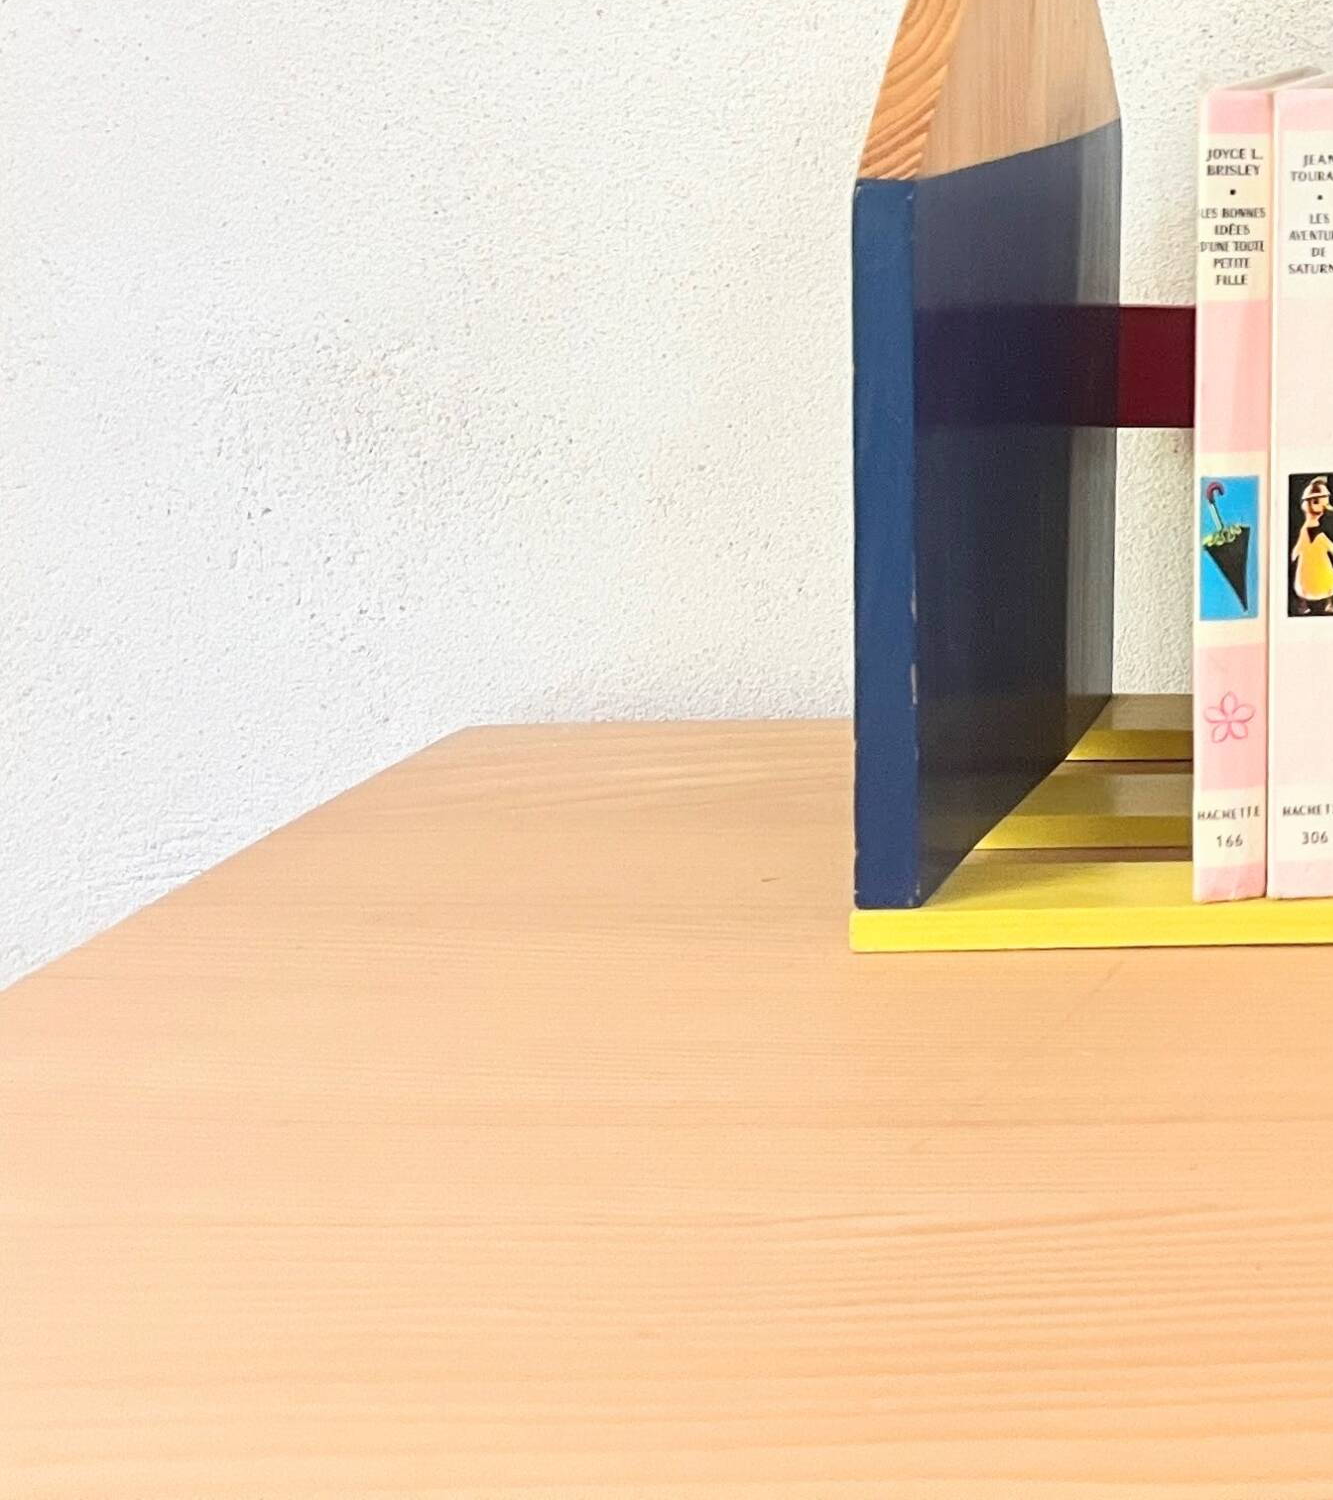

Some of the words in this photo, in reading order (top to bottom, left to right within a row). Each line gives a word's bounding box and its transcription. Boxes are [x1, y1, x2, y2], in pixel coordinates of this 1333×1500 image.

[1205, 148, 1246, 162] JOYCE
[1251, 148, 1264, 160] L.
[1206, 164, 1261, 176] BRISLEY
[1200, 208, 1217, 219] LES
[1221, 207, 1266, 219] BONNES
[1308, 213, 1330, 224] LES
[1311, 246, 1326, 258] DE
[1213, 257, 1250, 269] PETITE
[1215, 274, 1248, 286] FILLE
[1197, 805, 1261, 821] HACHETTE
[1216, 834, 1244, 848] 166
[1302, 831, 1329, 845] 306
